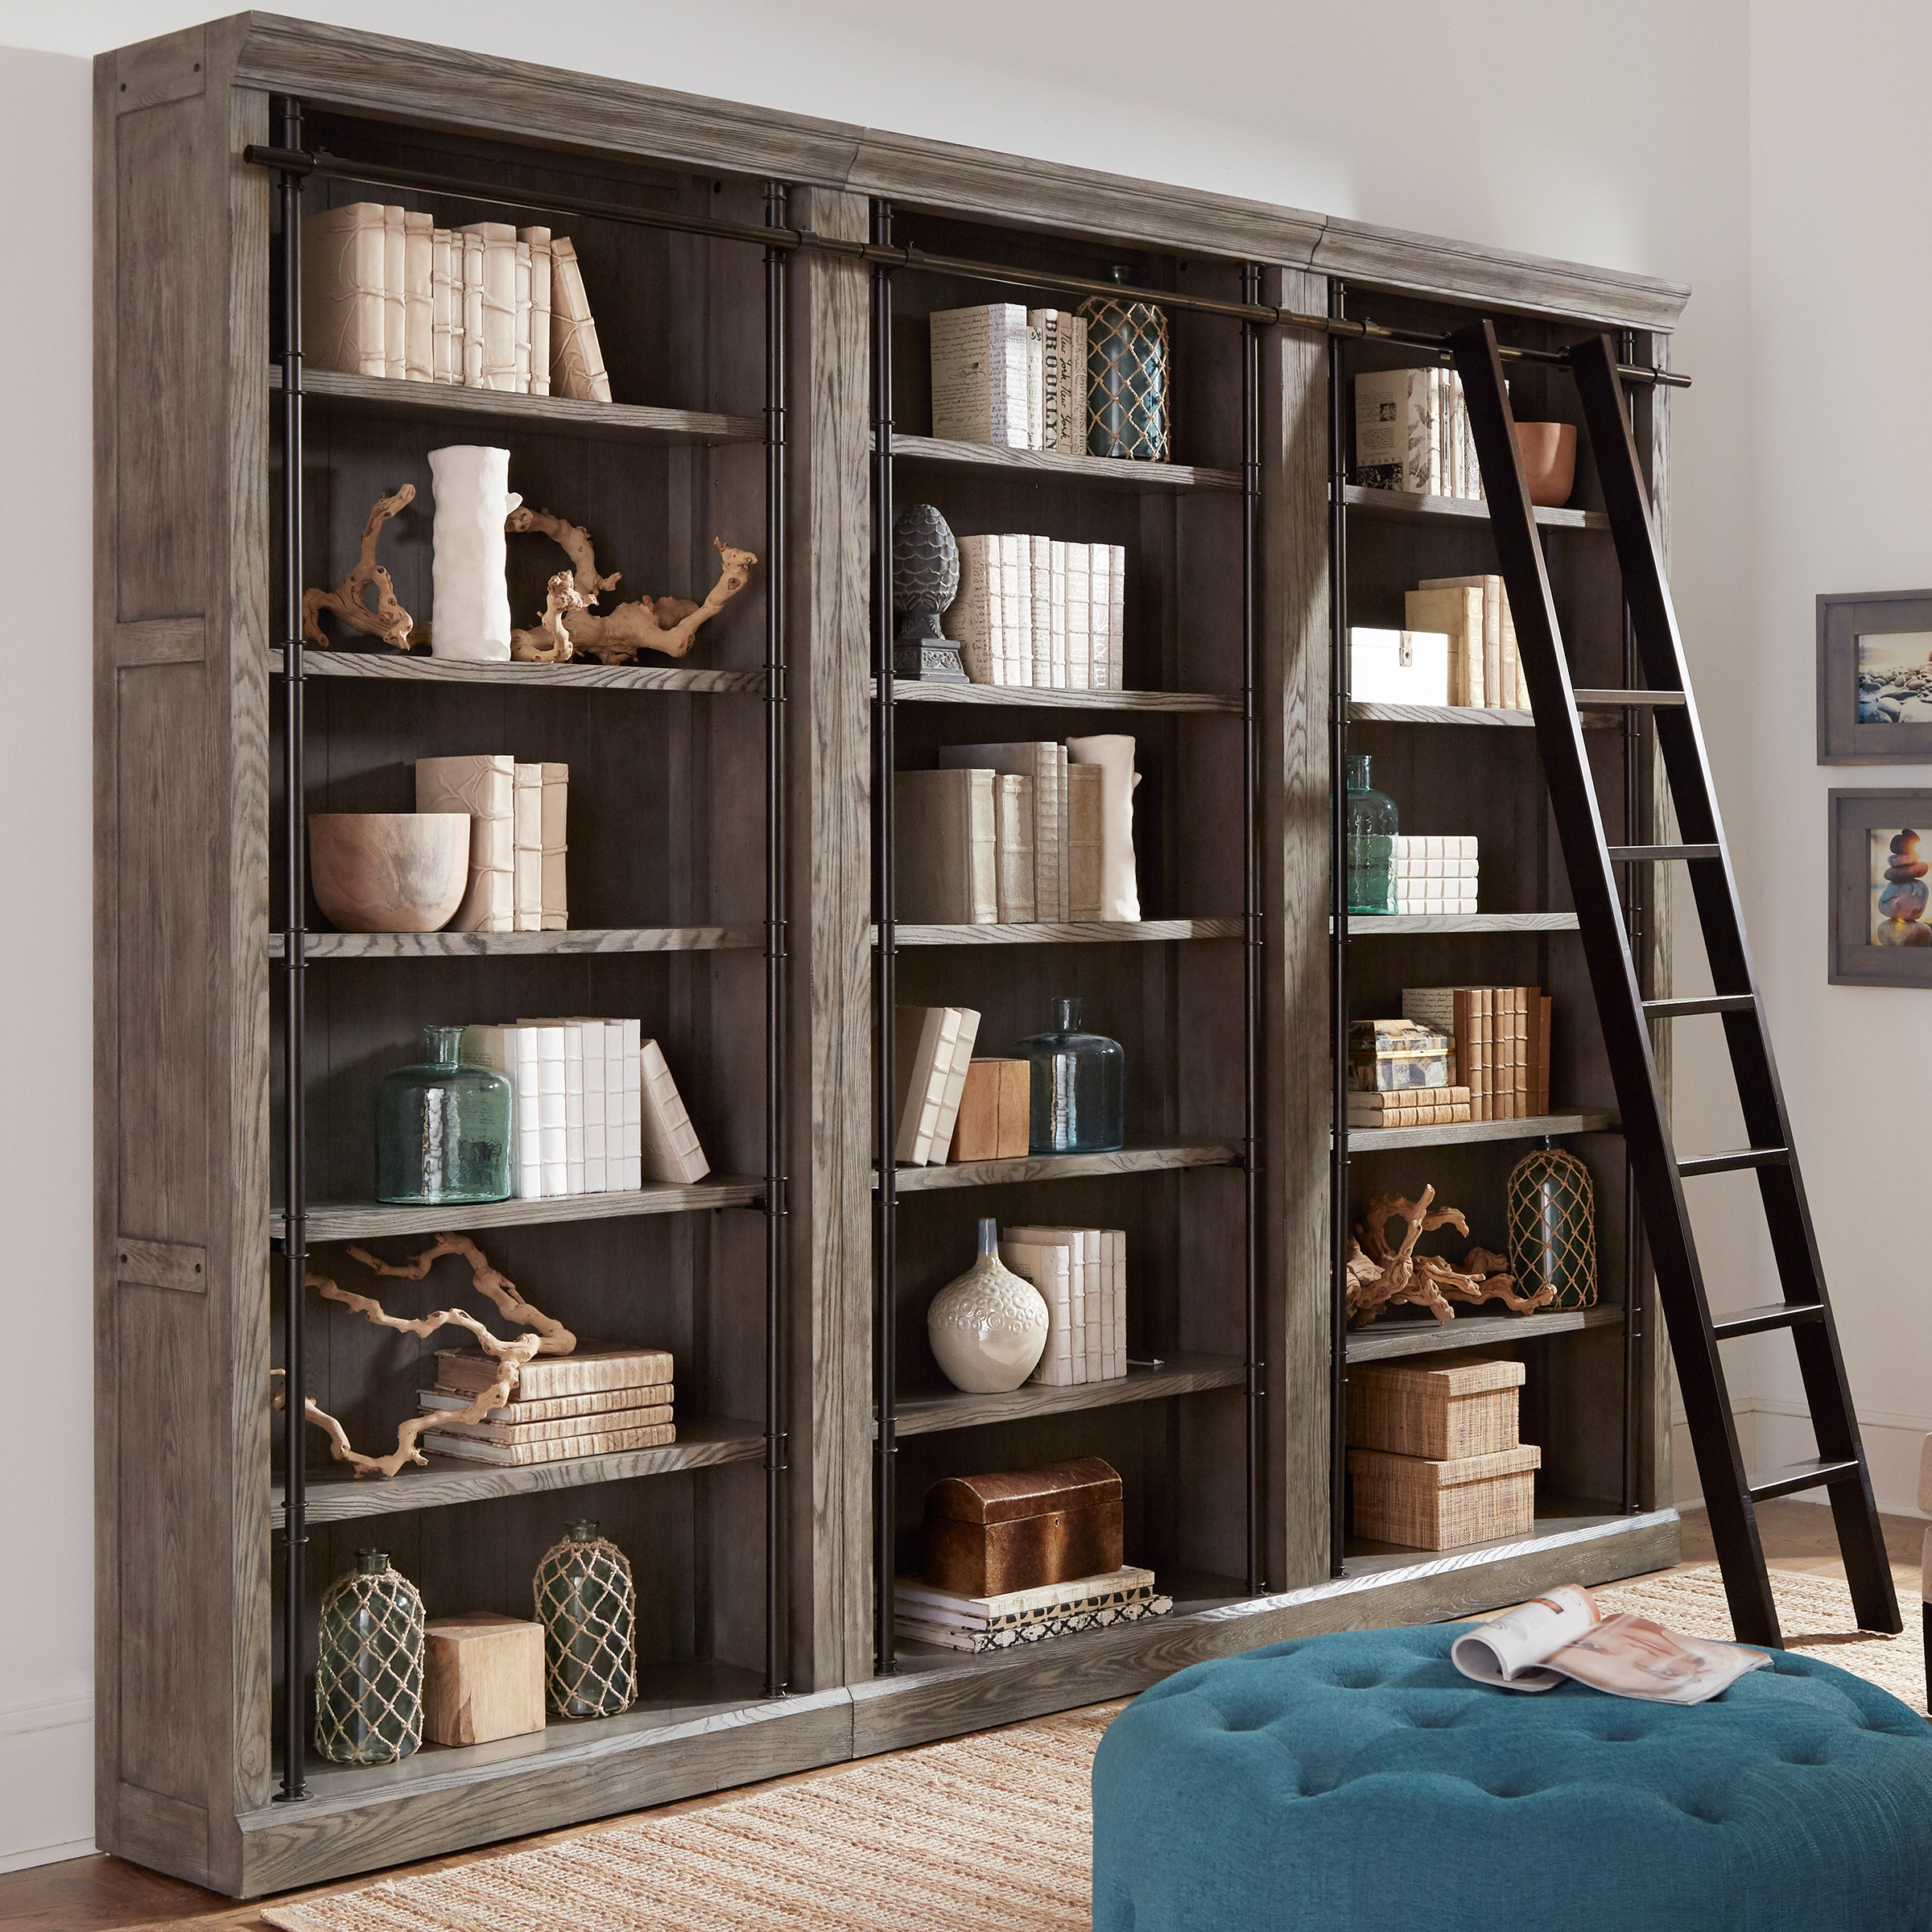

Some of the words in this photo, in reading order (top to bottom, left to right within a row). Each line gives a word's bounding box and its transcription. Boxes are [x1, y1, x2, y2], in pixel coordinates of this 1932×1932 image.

[1060, 331, 1071, 354] New
[1046, 318, 1057, 449] BROOKLYN
[1060, 386, 1071, 408] New
[1060, 413, 1071, 440] York
